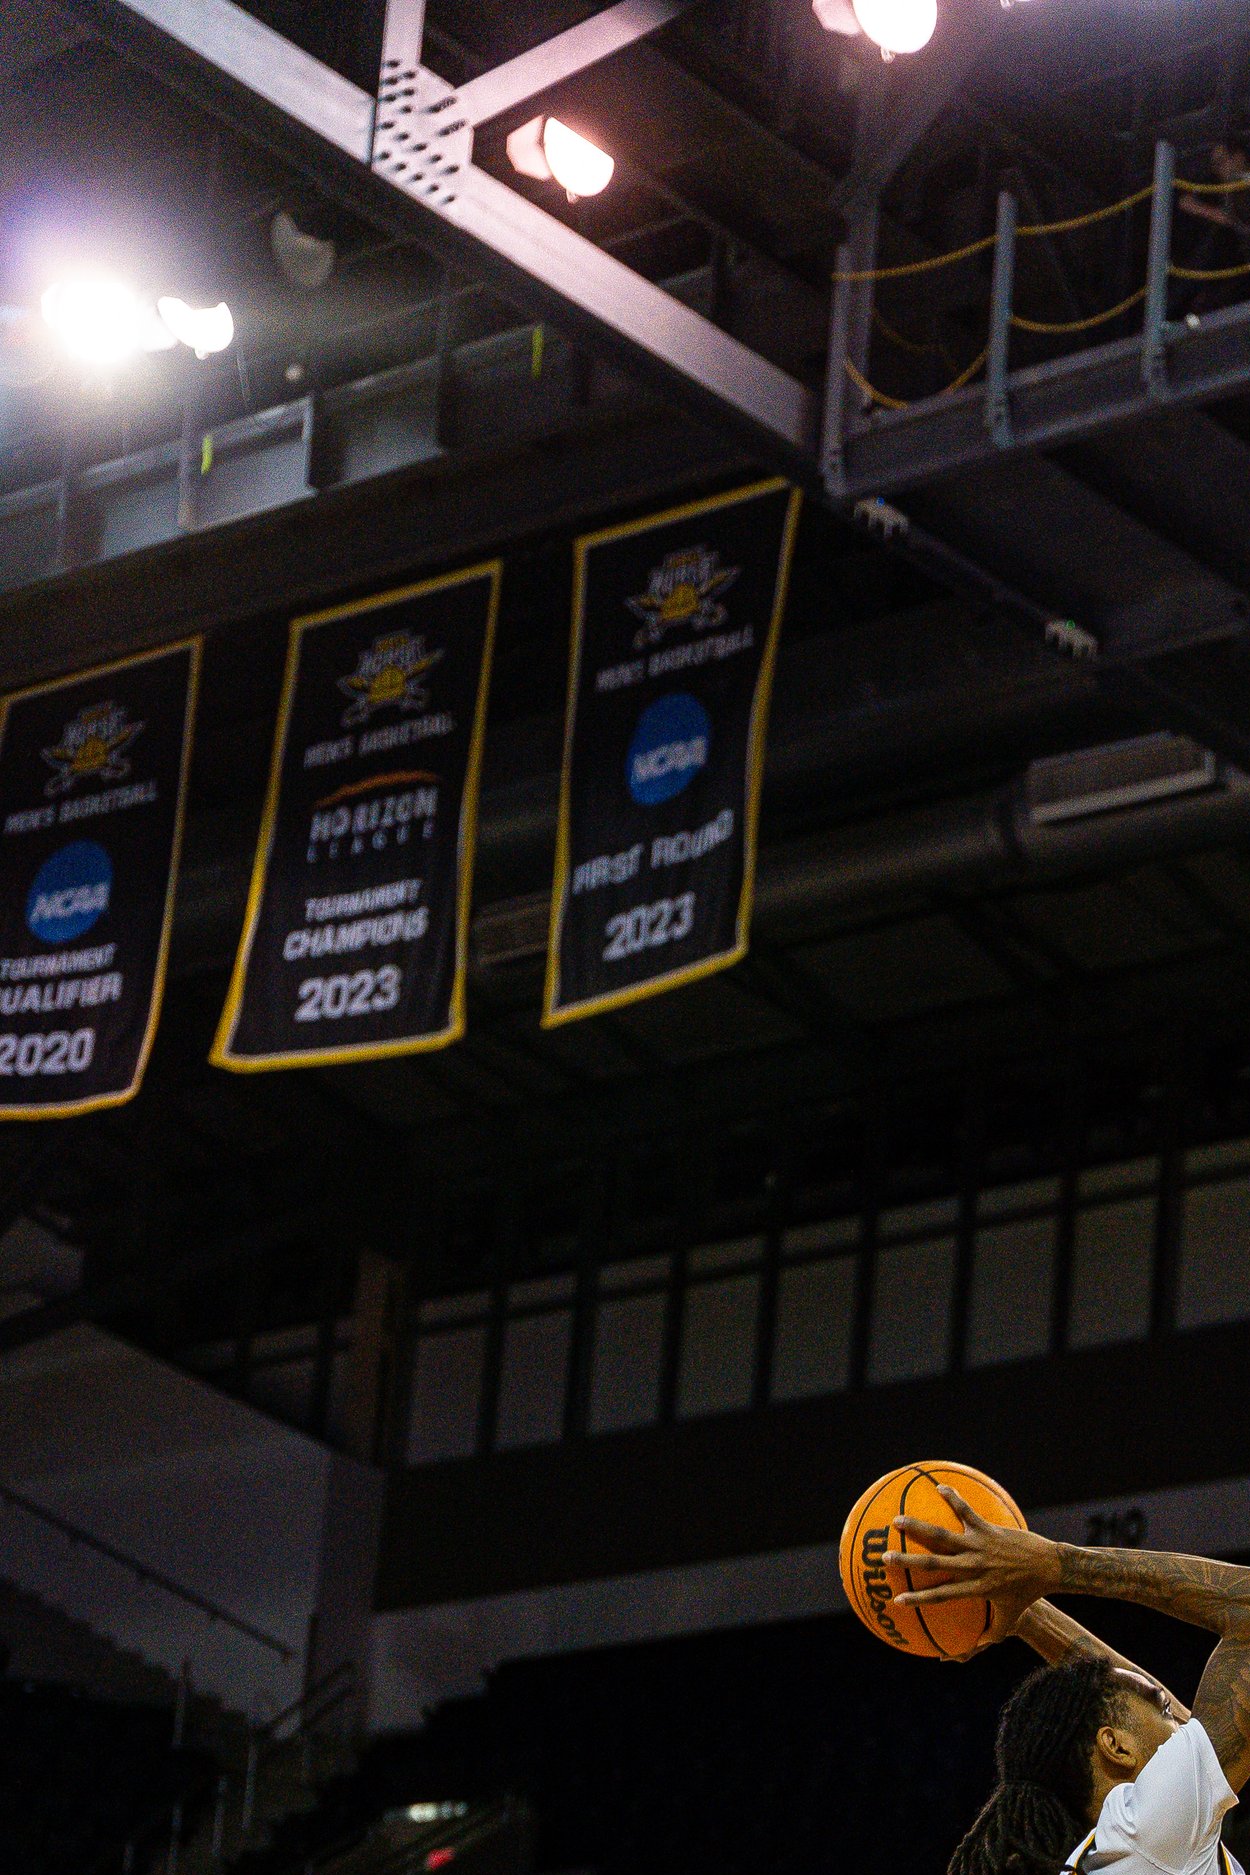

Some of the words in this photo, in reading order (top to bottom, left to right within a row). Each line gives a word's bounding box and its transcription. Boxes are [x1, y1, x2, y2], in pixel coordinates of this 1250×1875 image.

[631, 736, 708, 783] NCAA
[306, 817, 434, 863] LEAGUE
[310, 787, 439, 842] HORIZON
[572, 842, 644, 895] FIRST
[651, 808, 735, 869] ROUND
[29, 882, 111, 923] NCAA
[305, 878, 423, 922] TOURNAMENT
[283, 905, 429, 961] CHAMPIONS
[602, 891, 696, 962] 2023
[0, 972, 123, 1015] UALIFIER
[294, 964, 401, 1023] 2023
[0, 1028, 96, 1076] 2020
[861, 1524, 910, 1645] Wilson
